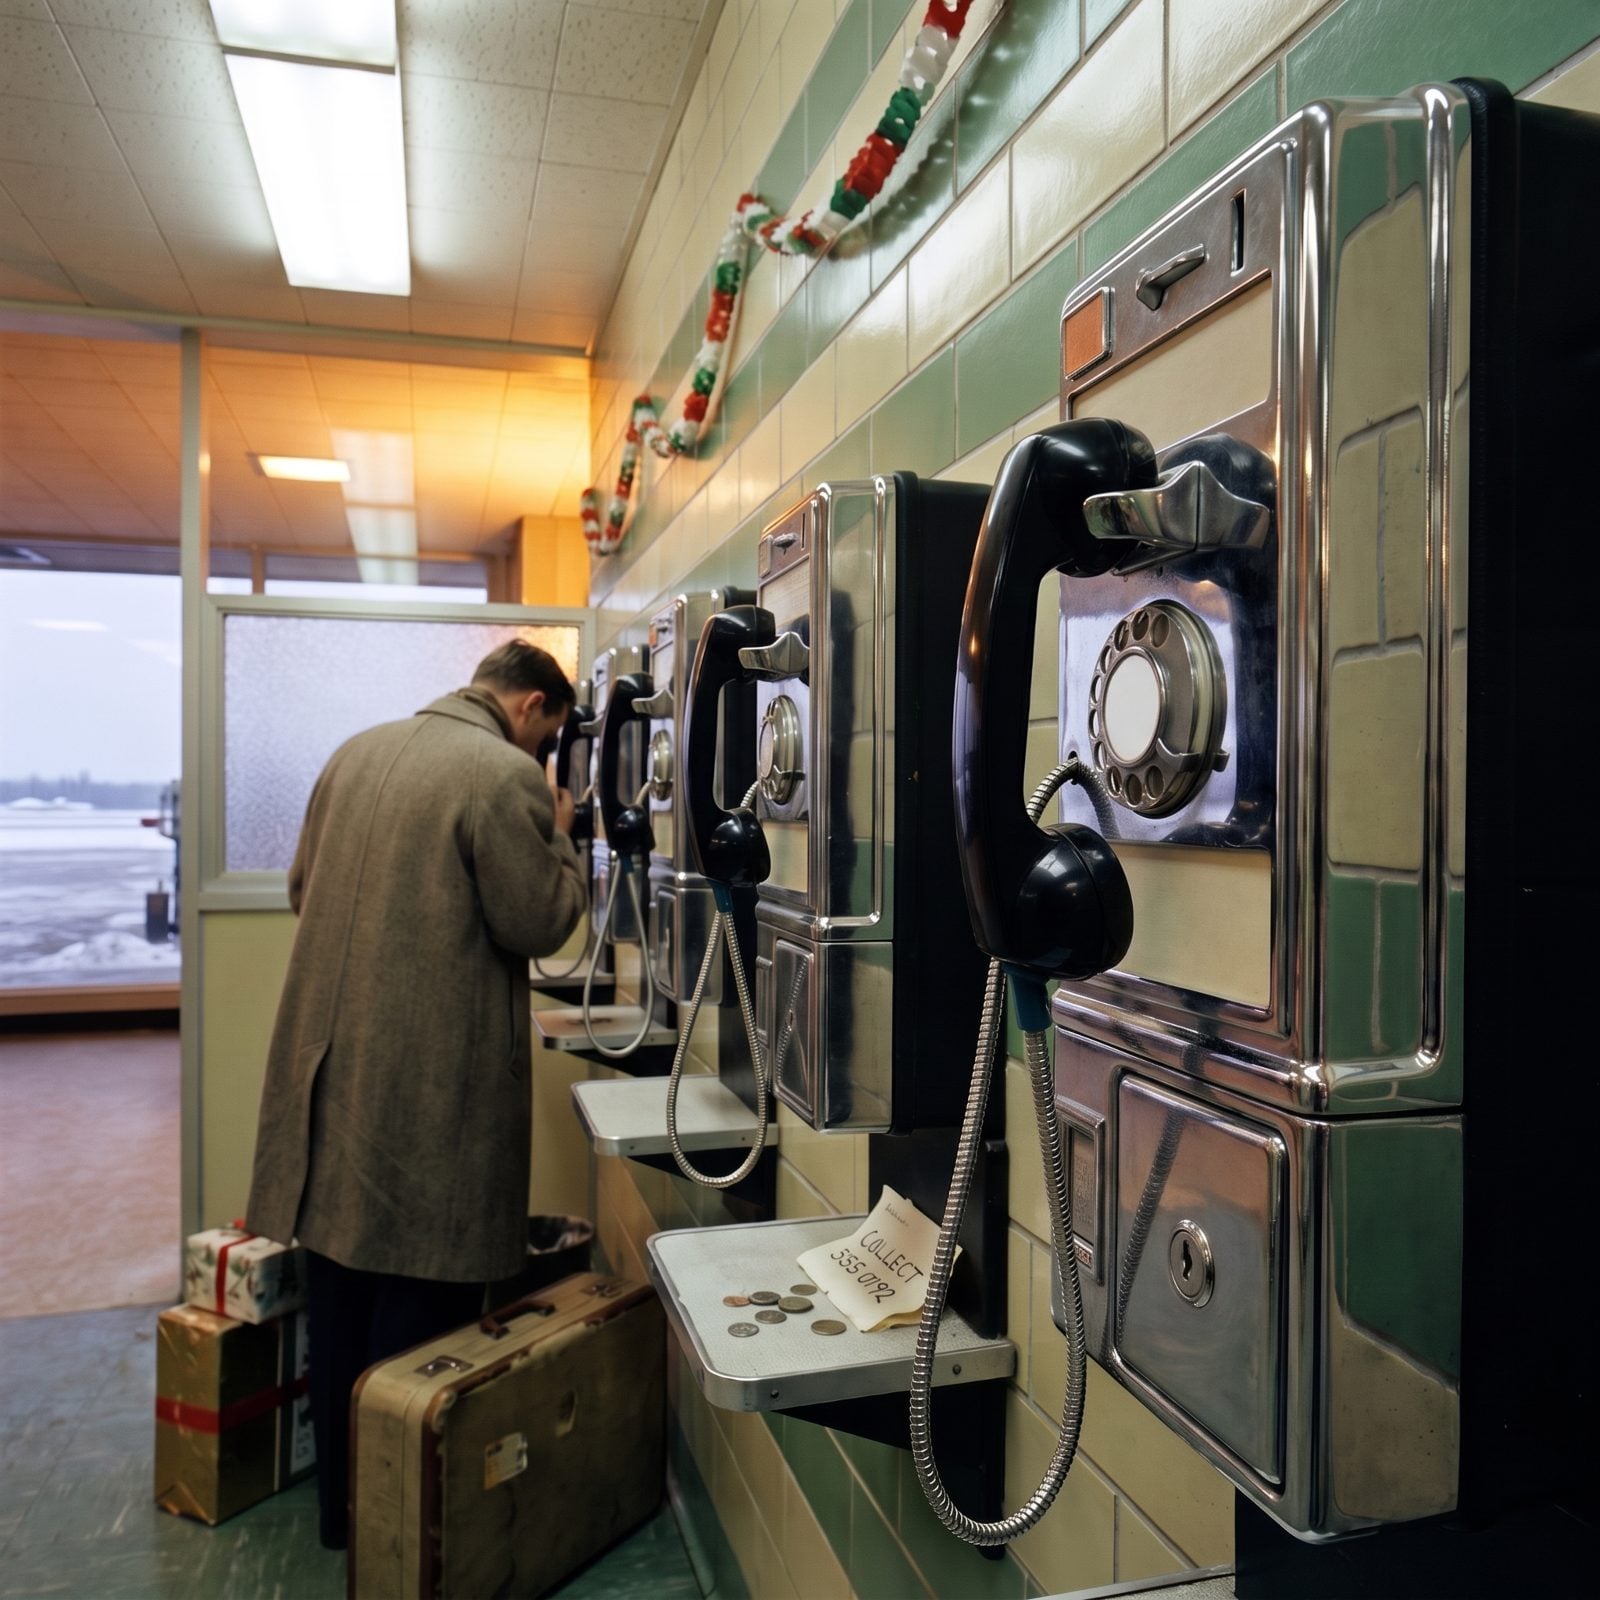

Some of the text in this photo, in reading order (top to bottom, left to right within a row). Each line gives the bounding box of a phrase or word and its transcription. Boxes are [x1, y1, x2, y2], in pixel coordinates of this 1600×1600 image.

[830, 1248, 896, 1304] 555 0192
[860, 1230, 924, 1283] COLLECT
